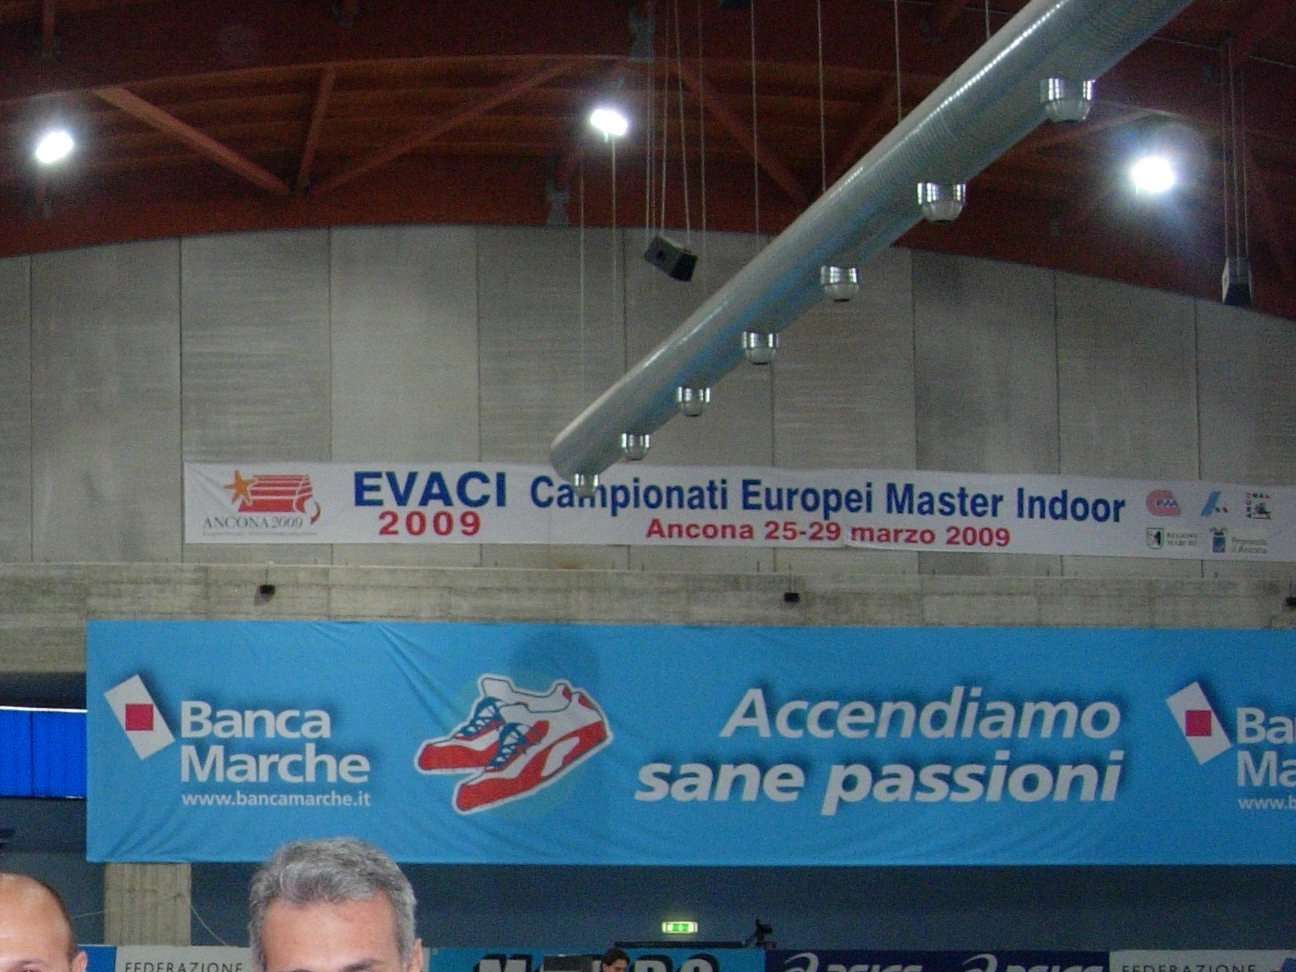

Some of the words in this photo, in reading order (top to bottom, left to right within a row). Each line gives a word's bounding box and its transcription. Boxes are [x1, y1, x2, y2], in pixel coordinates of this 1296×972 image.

[354, 471, 507, 508] EVACI
[529, 474, 729, 517] Campionati
[741, 479, 873, 521] Europei
[886, 482, 1004, 517] Master
[1017, 486, 1126, 523] Indoor
[378, 510, 482, 537] 2009
[645, 518, 754, 540] Ancona
[763, 520, 842, 541] 25-29
[850, 525, 936, 545] marzo
[945, 525, 1011, 547] 2009
[180, 700, 332, 740] Banca
[718, 685, 1122, 740] Accendiamo
[1236, 706, 1296, 745] Ba
[180, 742, 371, 784] Marche
[634, 762, 805, 802] sane
[820, 749, 1125, 817] passioni
[181, 789, 372, 807] www.bancamarche.it
